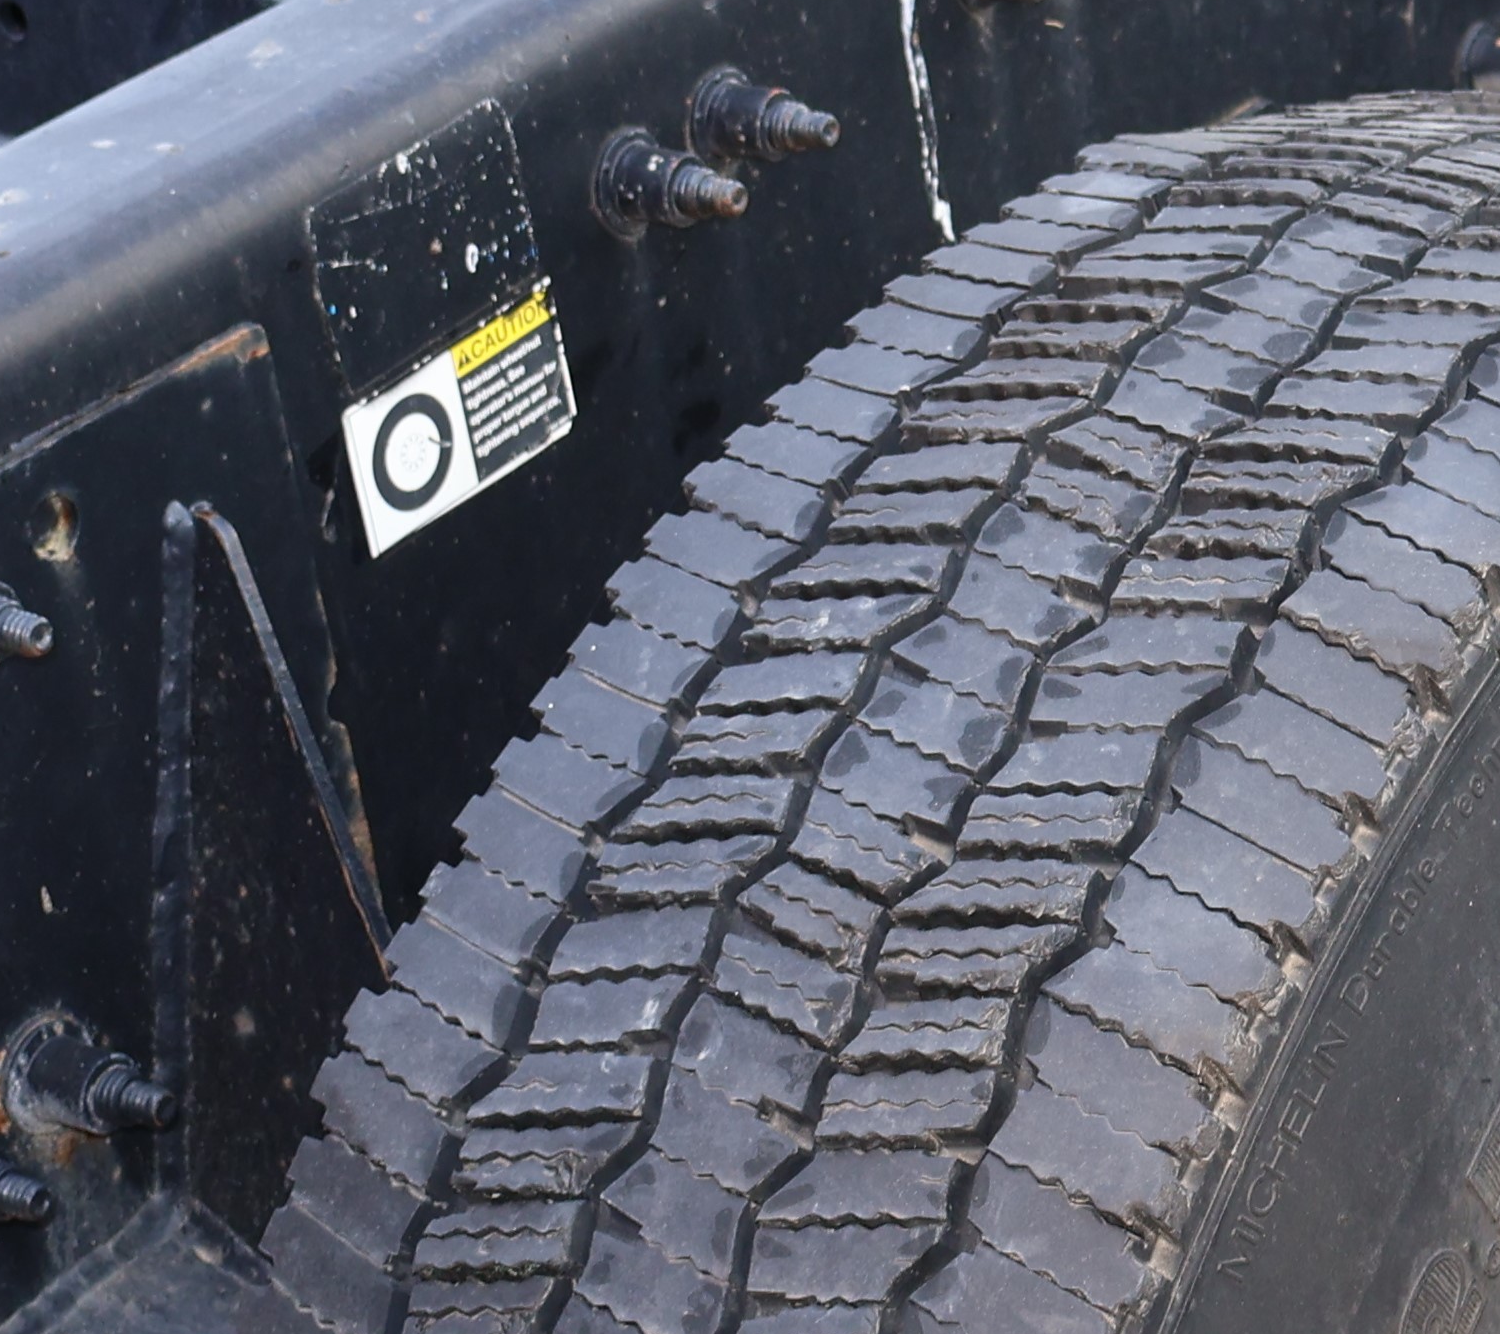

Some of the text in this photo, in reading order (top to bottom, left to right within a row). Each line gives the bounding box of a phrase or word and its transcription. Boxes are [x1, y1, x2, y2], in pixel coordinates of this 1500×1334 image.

[462, 362, 500, 395] Maintain
[506, 364, 526, 383] See
[543, 360, 557, 377] for
[530, 383, 548, 404] and
[1216, 1021, 1351, 1285] MICHELIN
[1340, 854, 1441, 1019] Durable
